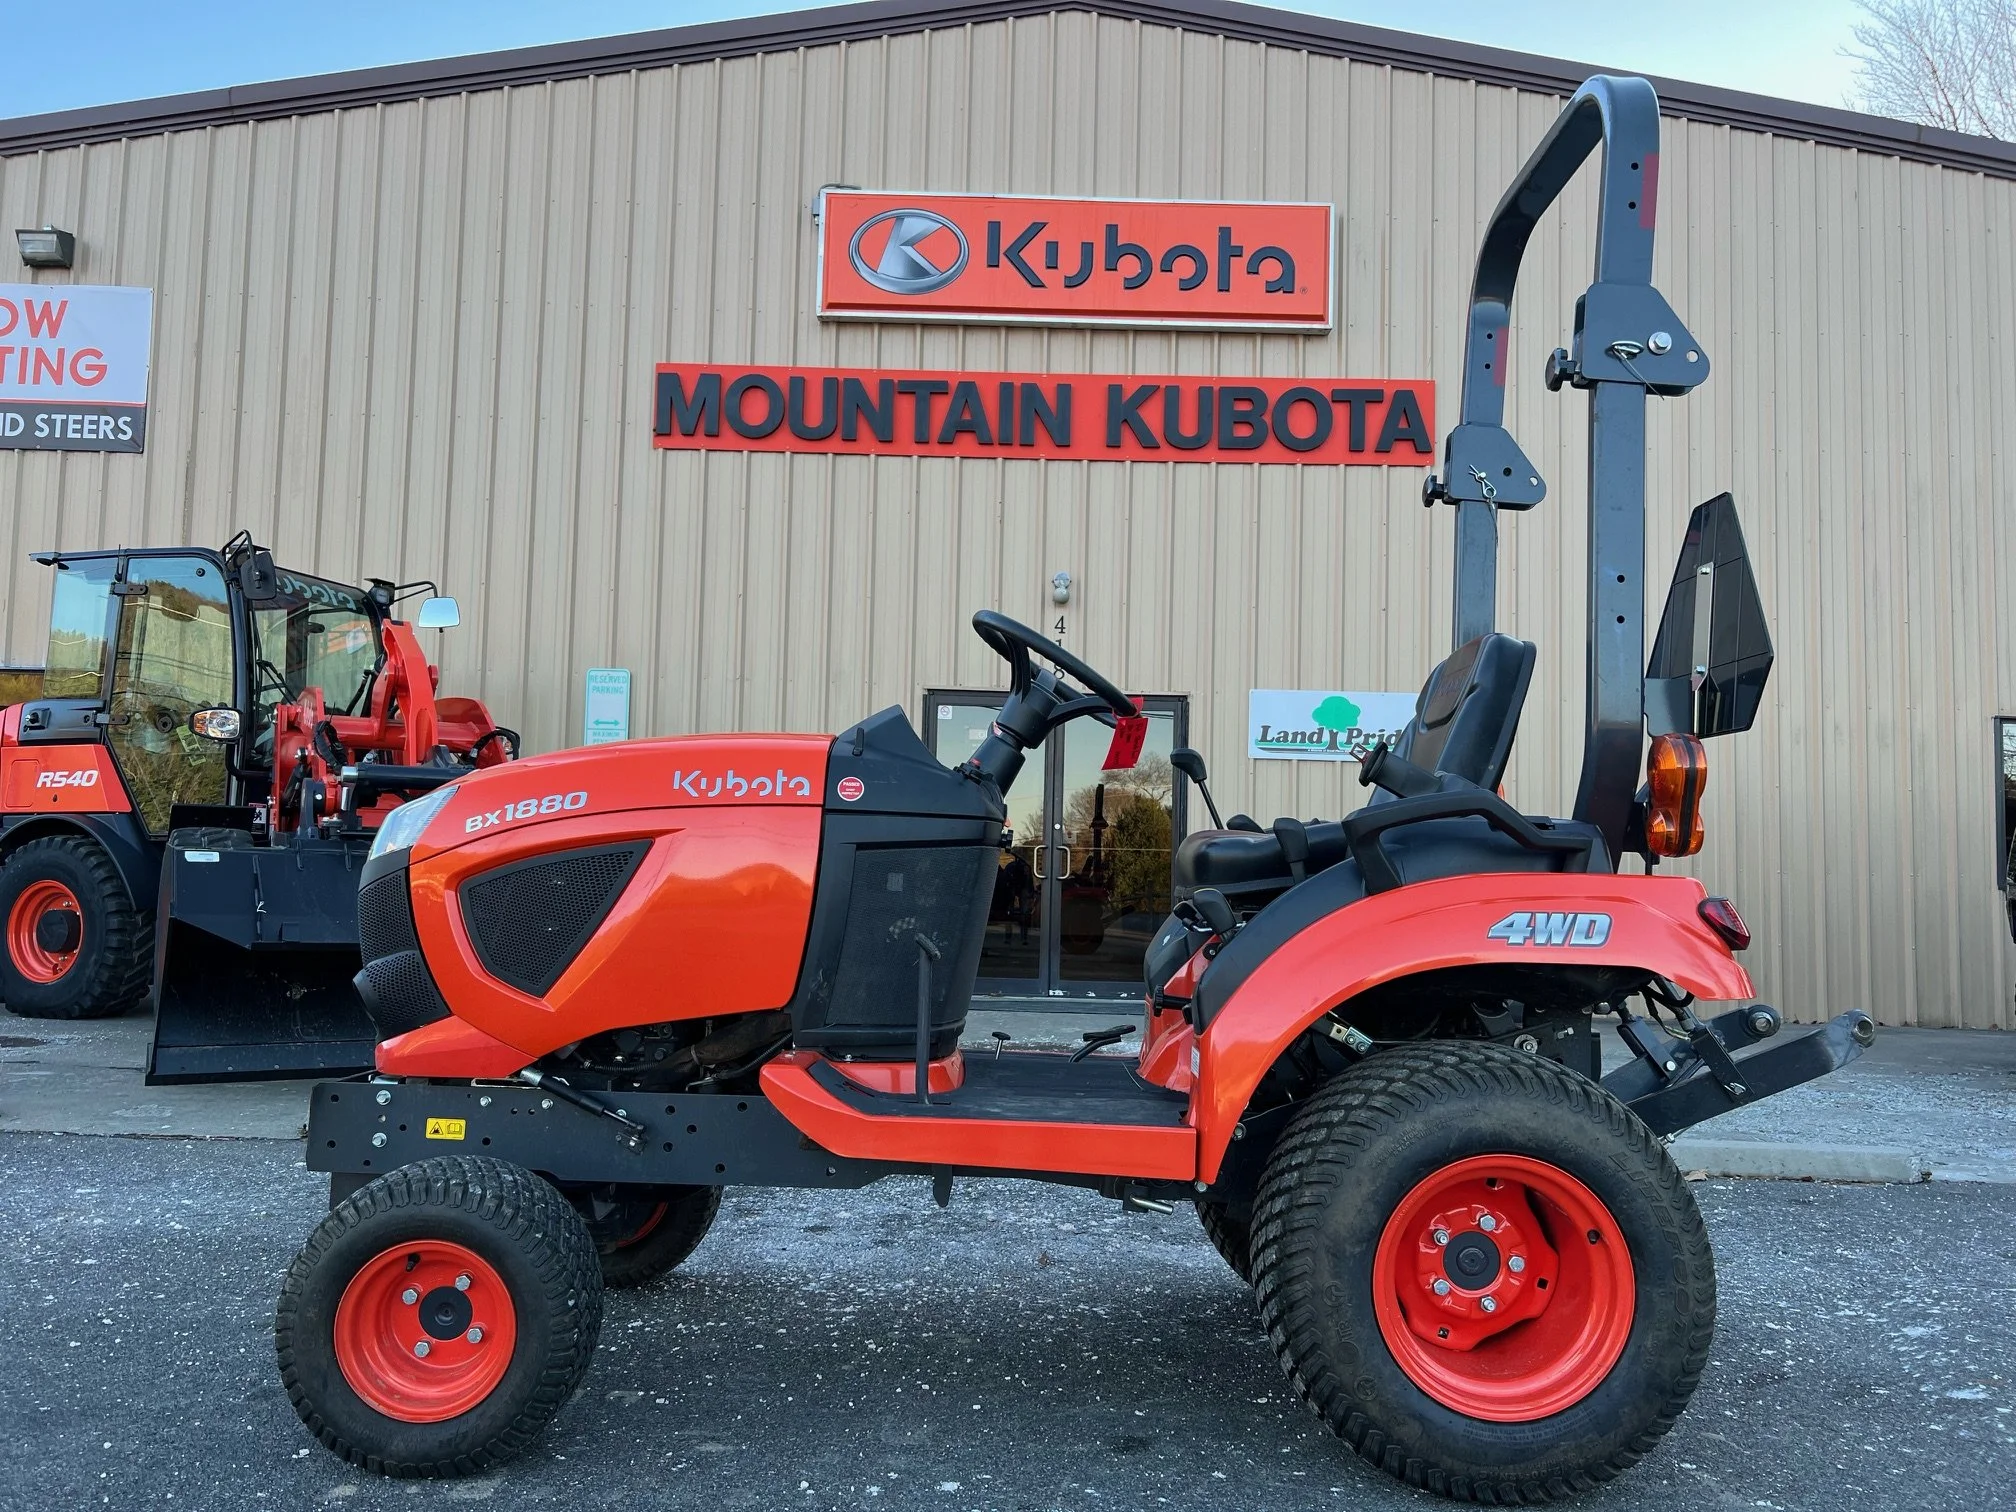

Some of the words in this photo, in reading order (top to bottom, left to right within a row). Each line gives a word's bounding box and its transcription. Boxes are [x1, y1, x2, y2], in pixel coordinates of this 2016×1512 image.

[987, 220, 1296, 294] Kubota
[0, 346, 108, 387] TING
[0, 412, 25, 437] D
[34, 413, 133, 441] STEERS
[654, 372, 1071, 448] MOUNTAIN
[1105, 383, 1434, 454] KUBOTA
[276, 574, 358, 611] ubota
[590, 675, 627, 684] RESERVED
[591, 686, 624, 694] PARKING
[1258, 725, 1325, 745] Land
[1344, 727, 1403, 747] Prid
[36, 769, 99, 788] R540
[673, 769, 810, 798] Kubota
[465, 791, 588, 833] BX1880
[1487, 911, 1613, 947] 4WD
